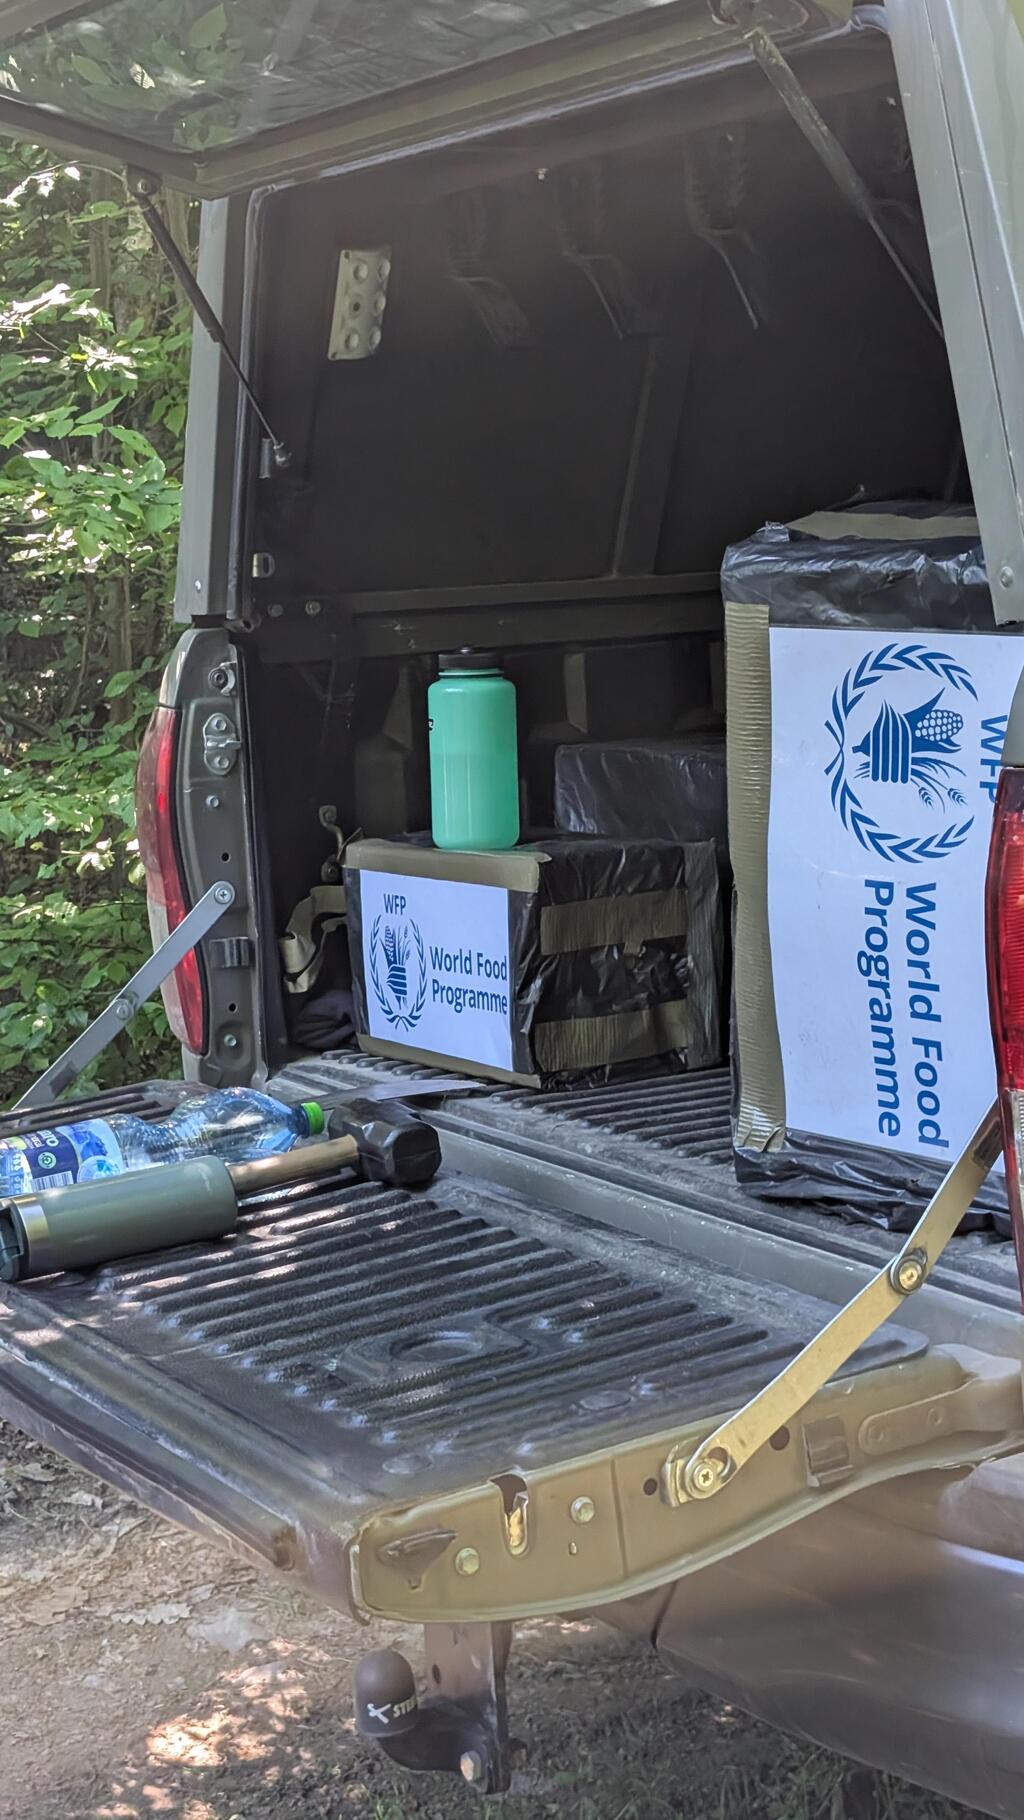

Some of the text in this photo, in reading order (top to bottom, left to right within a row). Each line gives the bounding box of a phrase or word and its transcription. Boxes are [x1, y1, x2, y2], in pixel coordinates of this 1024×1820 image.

[383, 893, 407, 916] WFP
[429, 945, 508, 981] World Food
[432, 978, 508, 1014] Programme
[857, 879, 901, 1137] Programme
[905, 882, 950, 1149] World Food
